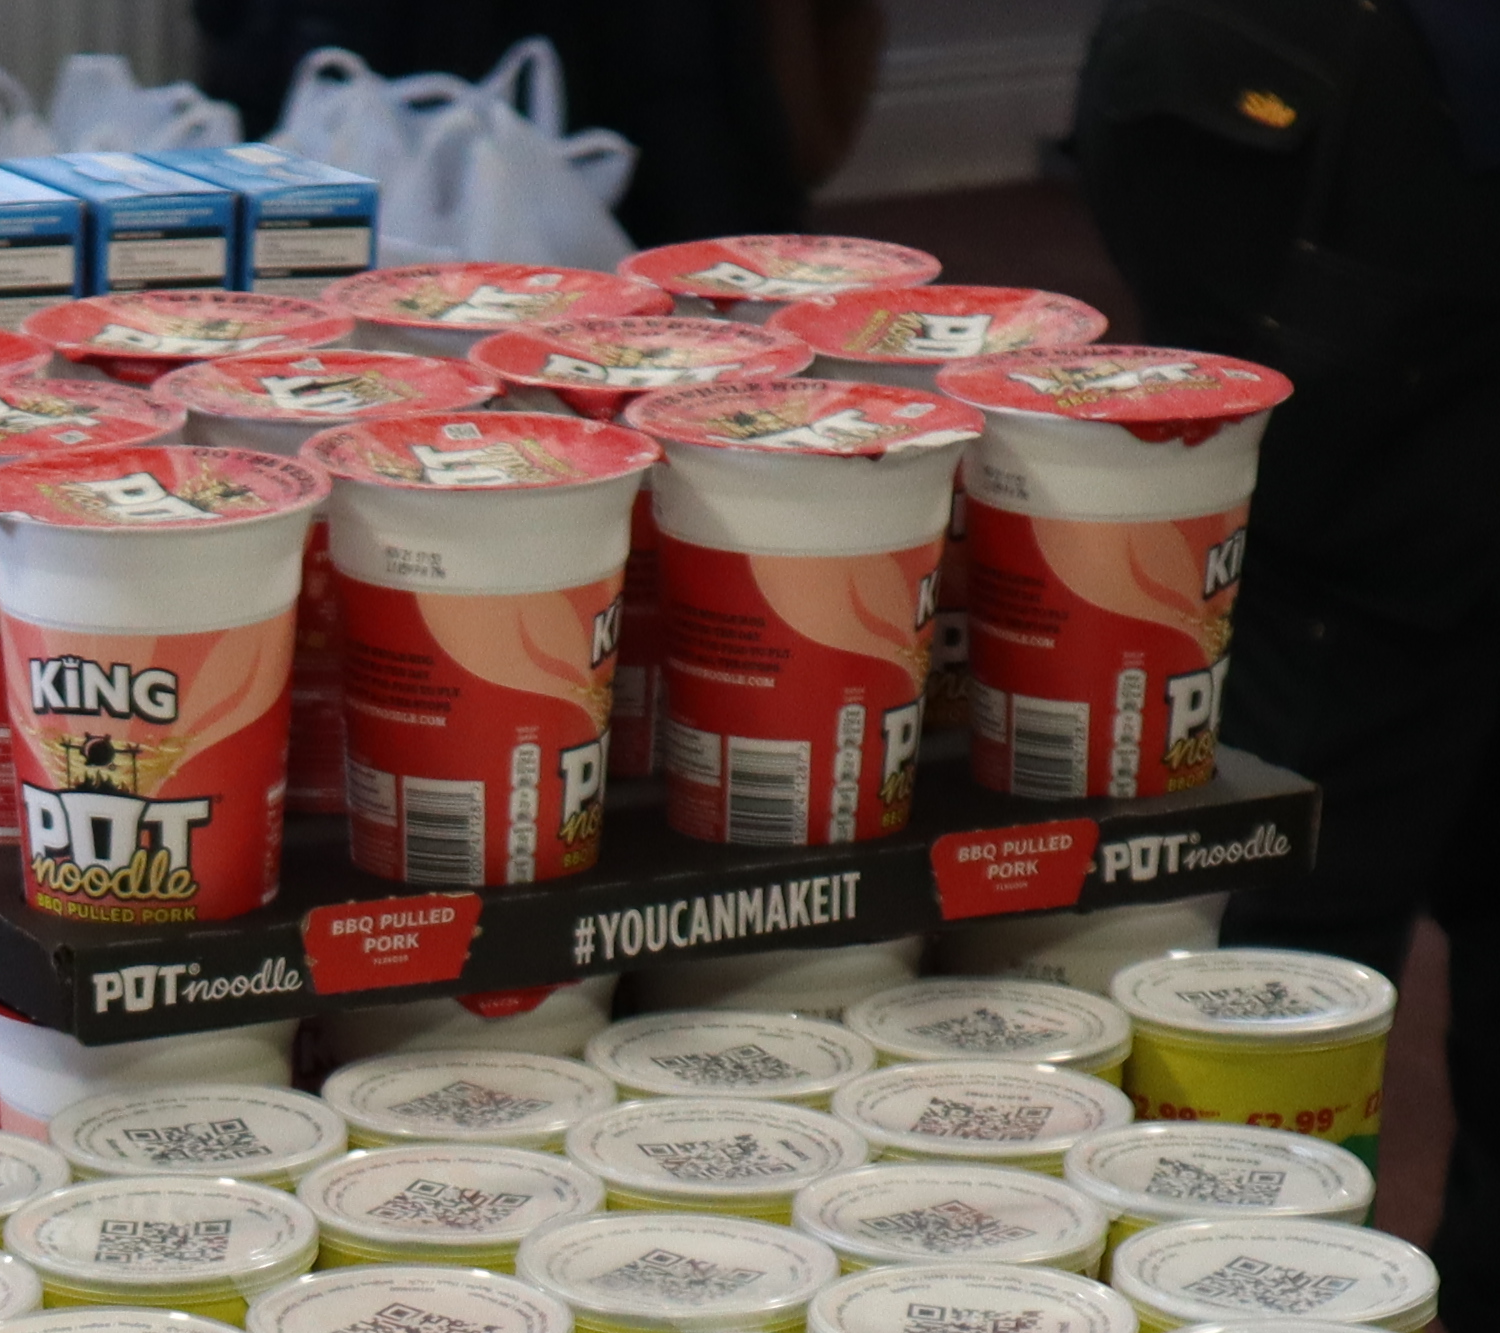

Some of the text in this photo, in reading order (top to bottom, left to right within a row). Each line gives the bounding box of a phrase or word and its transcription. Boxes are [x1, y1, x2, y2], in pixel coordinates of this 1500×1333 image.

[29, 655, 178, 723] KING
[22, 782, 212, 870] POT
[957, 834, 1074, 863] BBQ PULLED
[31, 849, 199, 900] noodle
[987, 859, 1039, 880] PORK
[1103, 823, 1291, 882] POT noodle
[37, 895, 197, 923] BBQ PULLED PORK
[331, 907, 456, 937] BBQ PULLED
[573, 872, 860, 965] #YOUCANMAKEIT
[363, 933, 420, 953] PORK
[92, 957, 304, 1014] POT noodle
